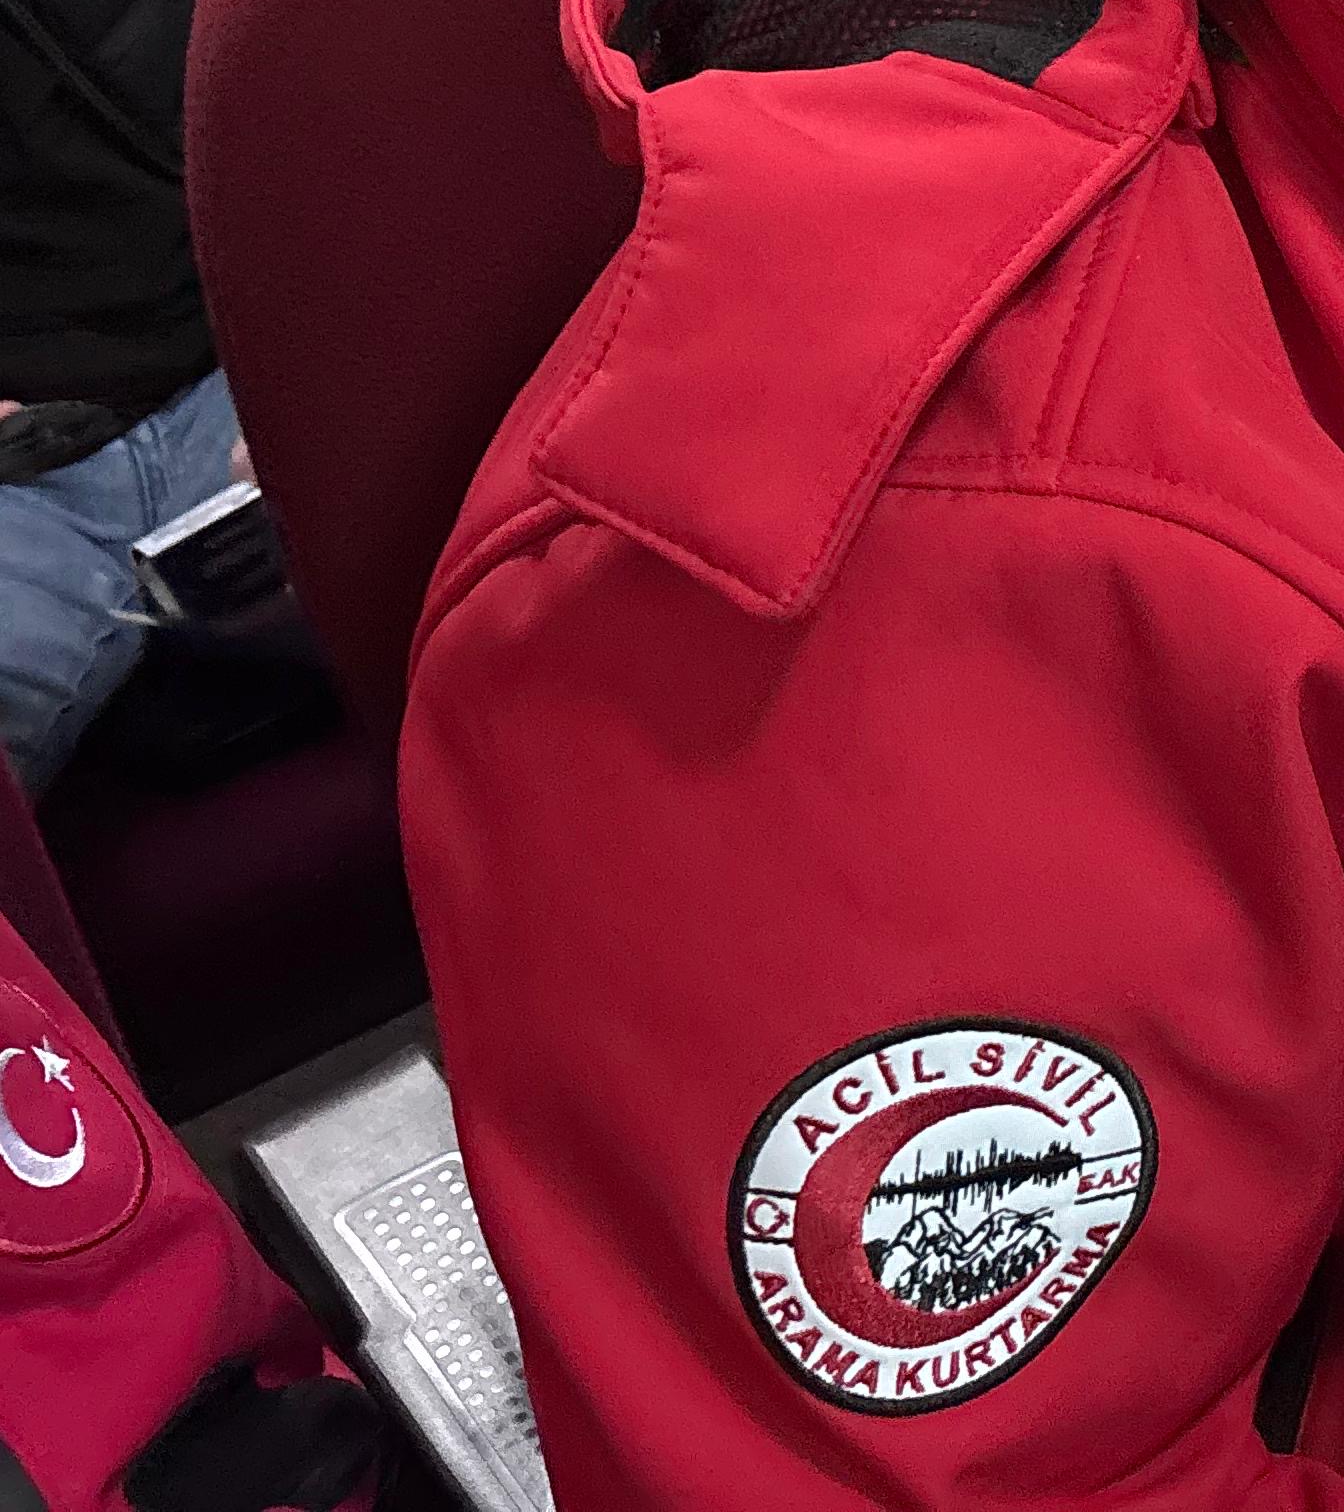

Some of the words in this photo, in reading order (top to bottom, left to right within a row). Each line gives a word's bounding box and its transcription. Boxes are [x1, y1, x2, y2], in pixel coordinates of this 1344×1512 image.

[793, 1048, 945, 1155] ACİL
[969, 1037, 1118, 1137] SİVİL
[753, 1269, 880, 1396] ARAMA
[894, 1218, 1122, 1396] KURTARMA
